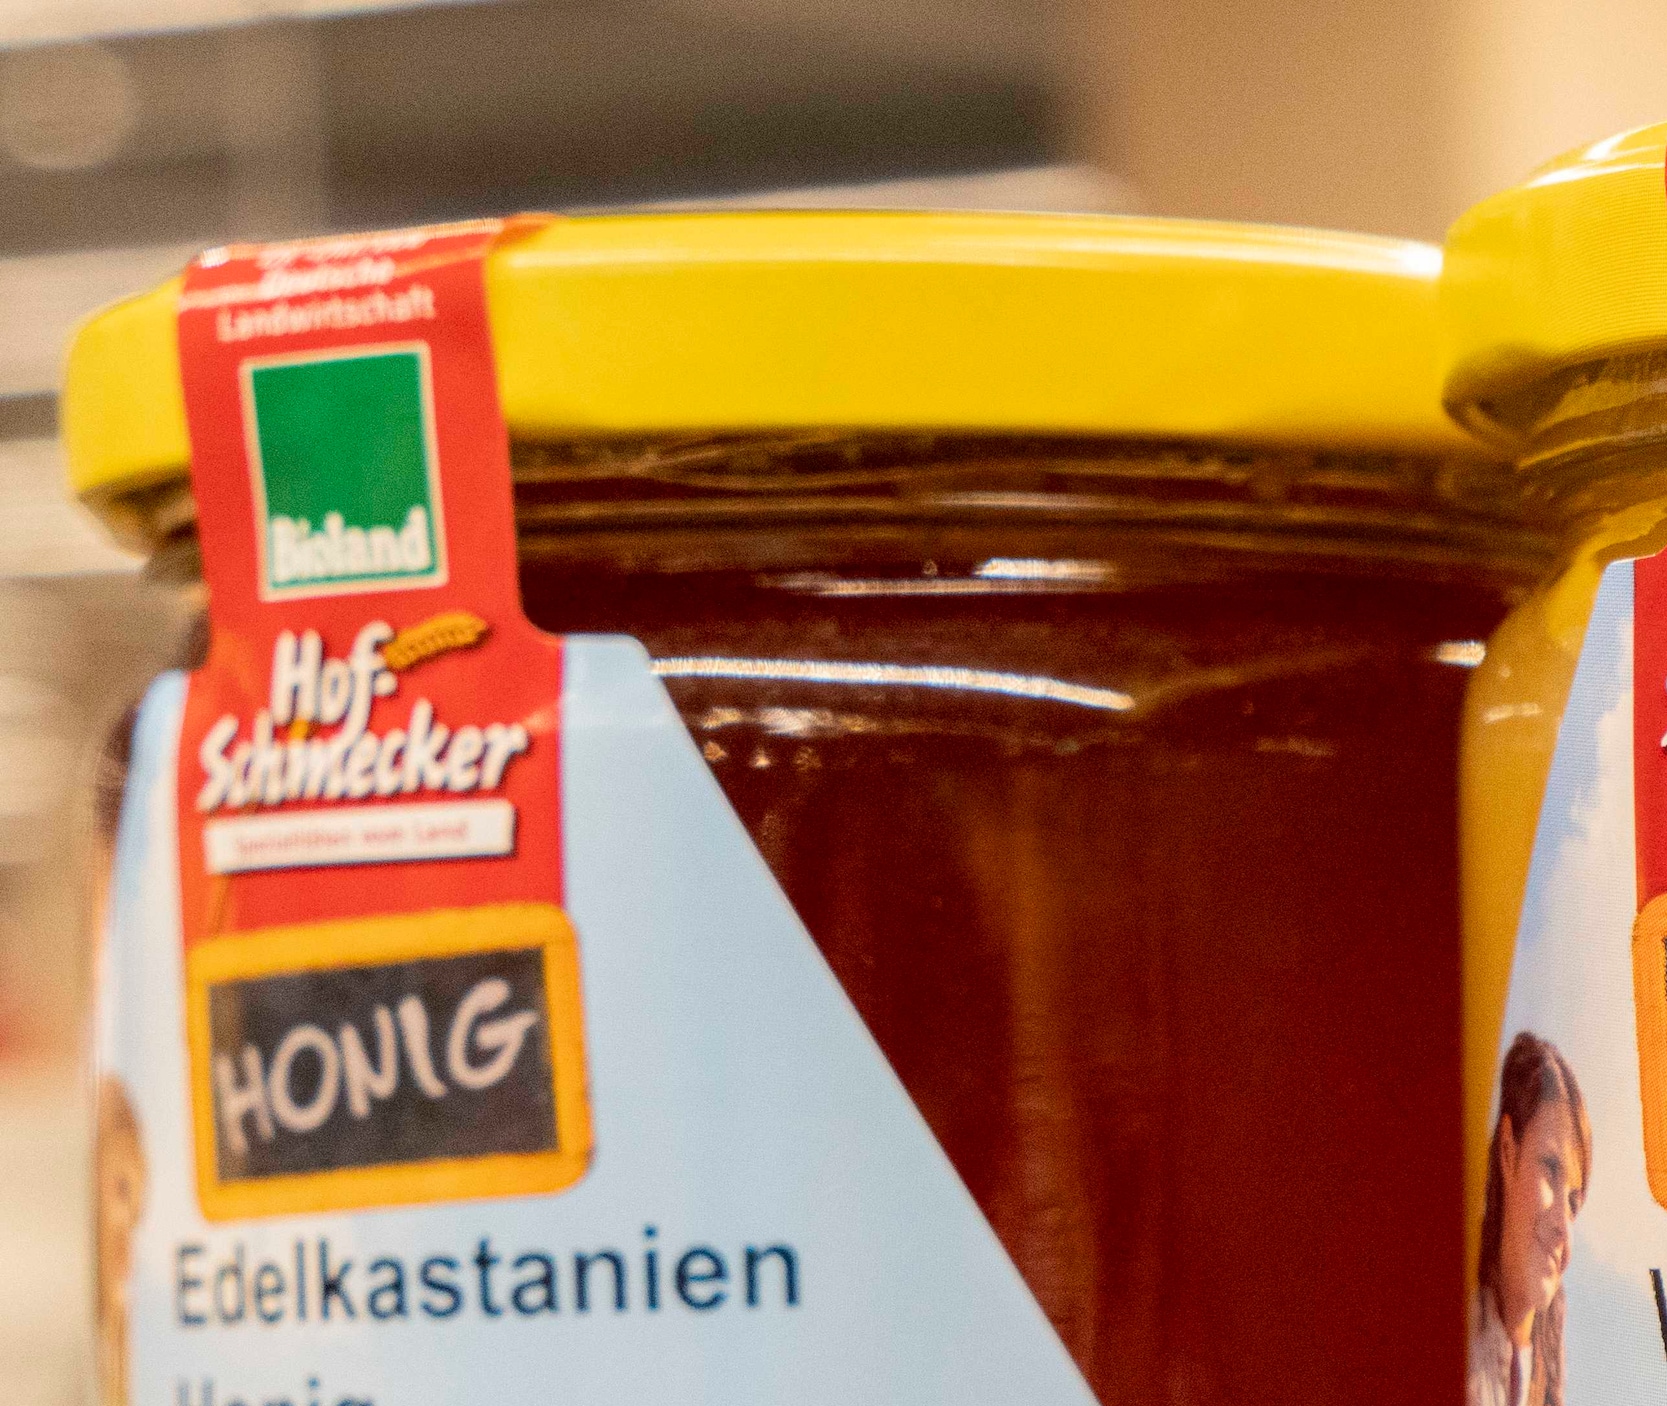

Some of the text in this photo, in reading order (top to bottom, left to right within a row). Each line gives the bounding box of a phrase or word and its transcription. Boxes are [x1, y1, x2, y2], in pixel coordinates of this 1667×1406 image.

[216, 284, 436, 342] Landwirtschaft
[269, 505, 433, 584] Bioland
[196, 699, 530, 811] Schmecker
[214, 977, 539, 1158] HONIG
[175, 1226, 802, 1330] Edelkastanien
